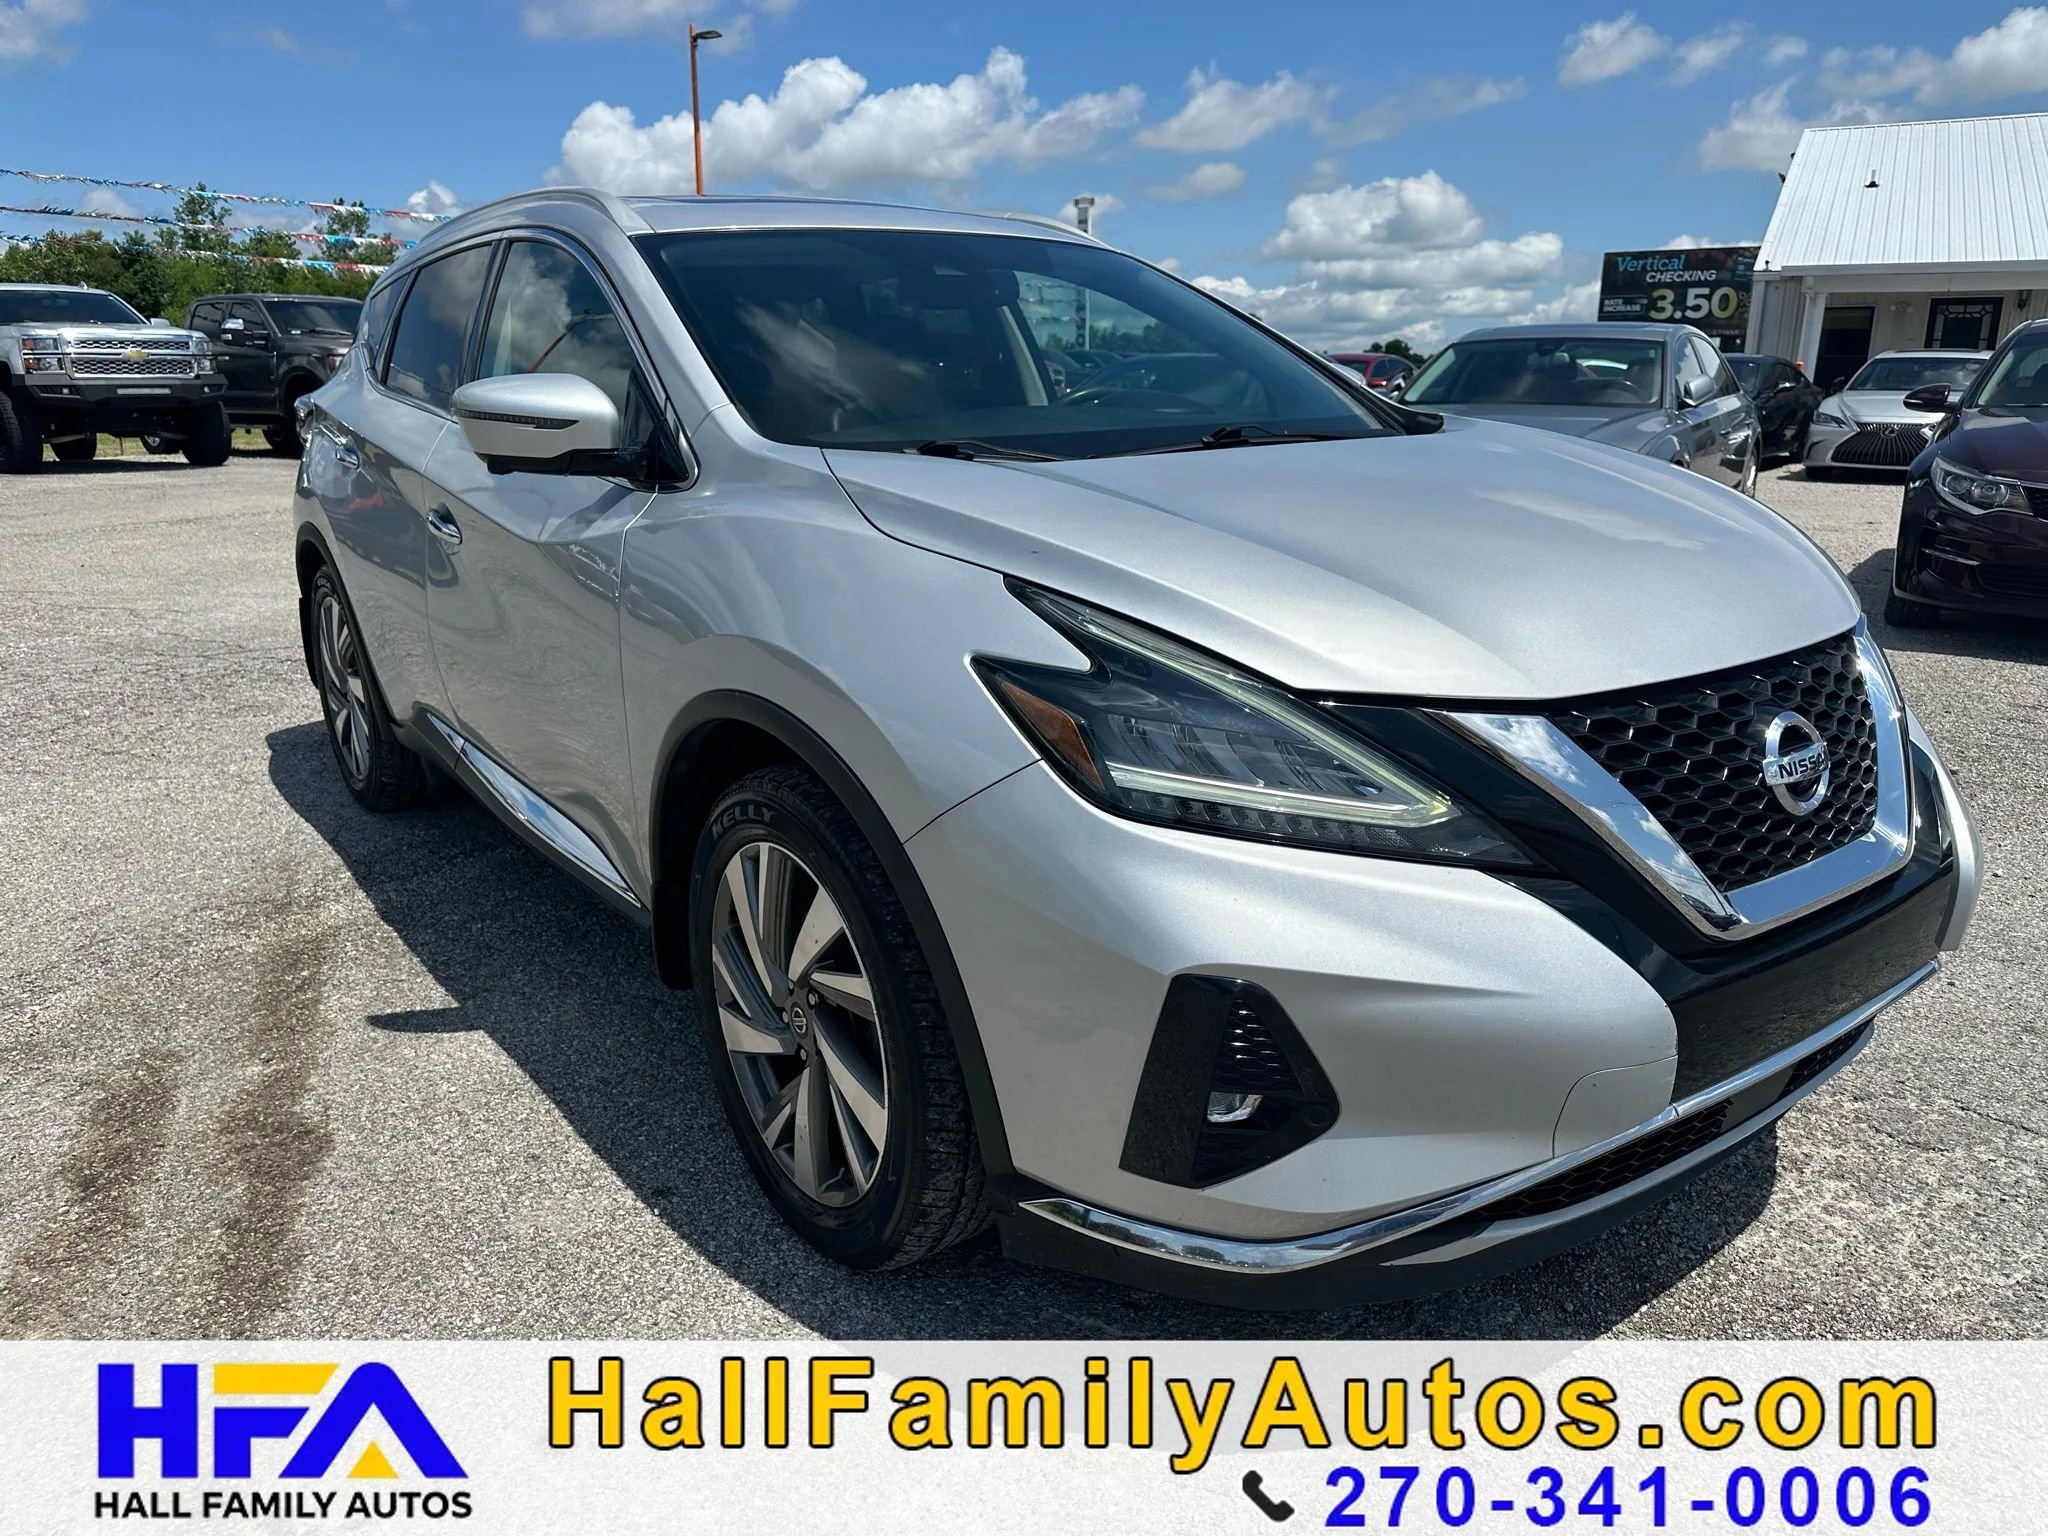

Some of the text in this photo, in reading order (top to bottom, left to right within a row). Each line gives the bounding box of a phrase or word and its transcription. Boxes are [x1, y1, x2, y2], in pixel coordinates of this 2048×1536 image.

[1616, 254, 1685, 272] Vertical
[1645, 269, 1717, 283] CHECKING
[711, 804, 777, 841] KELLY
